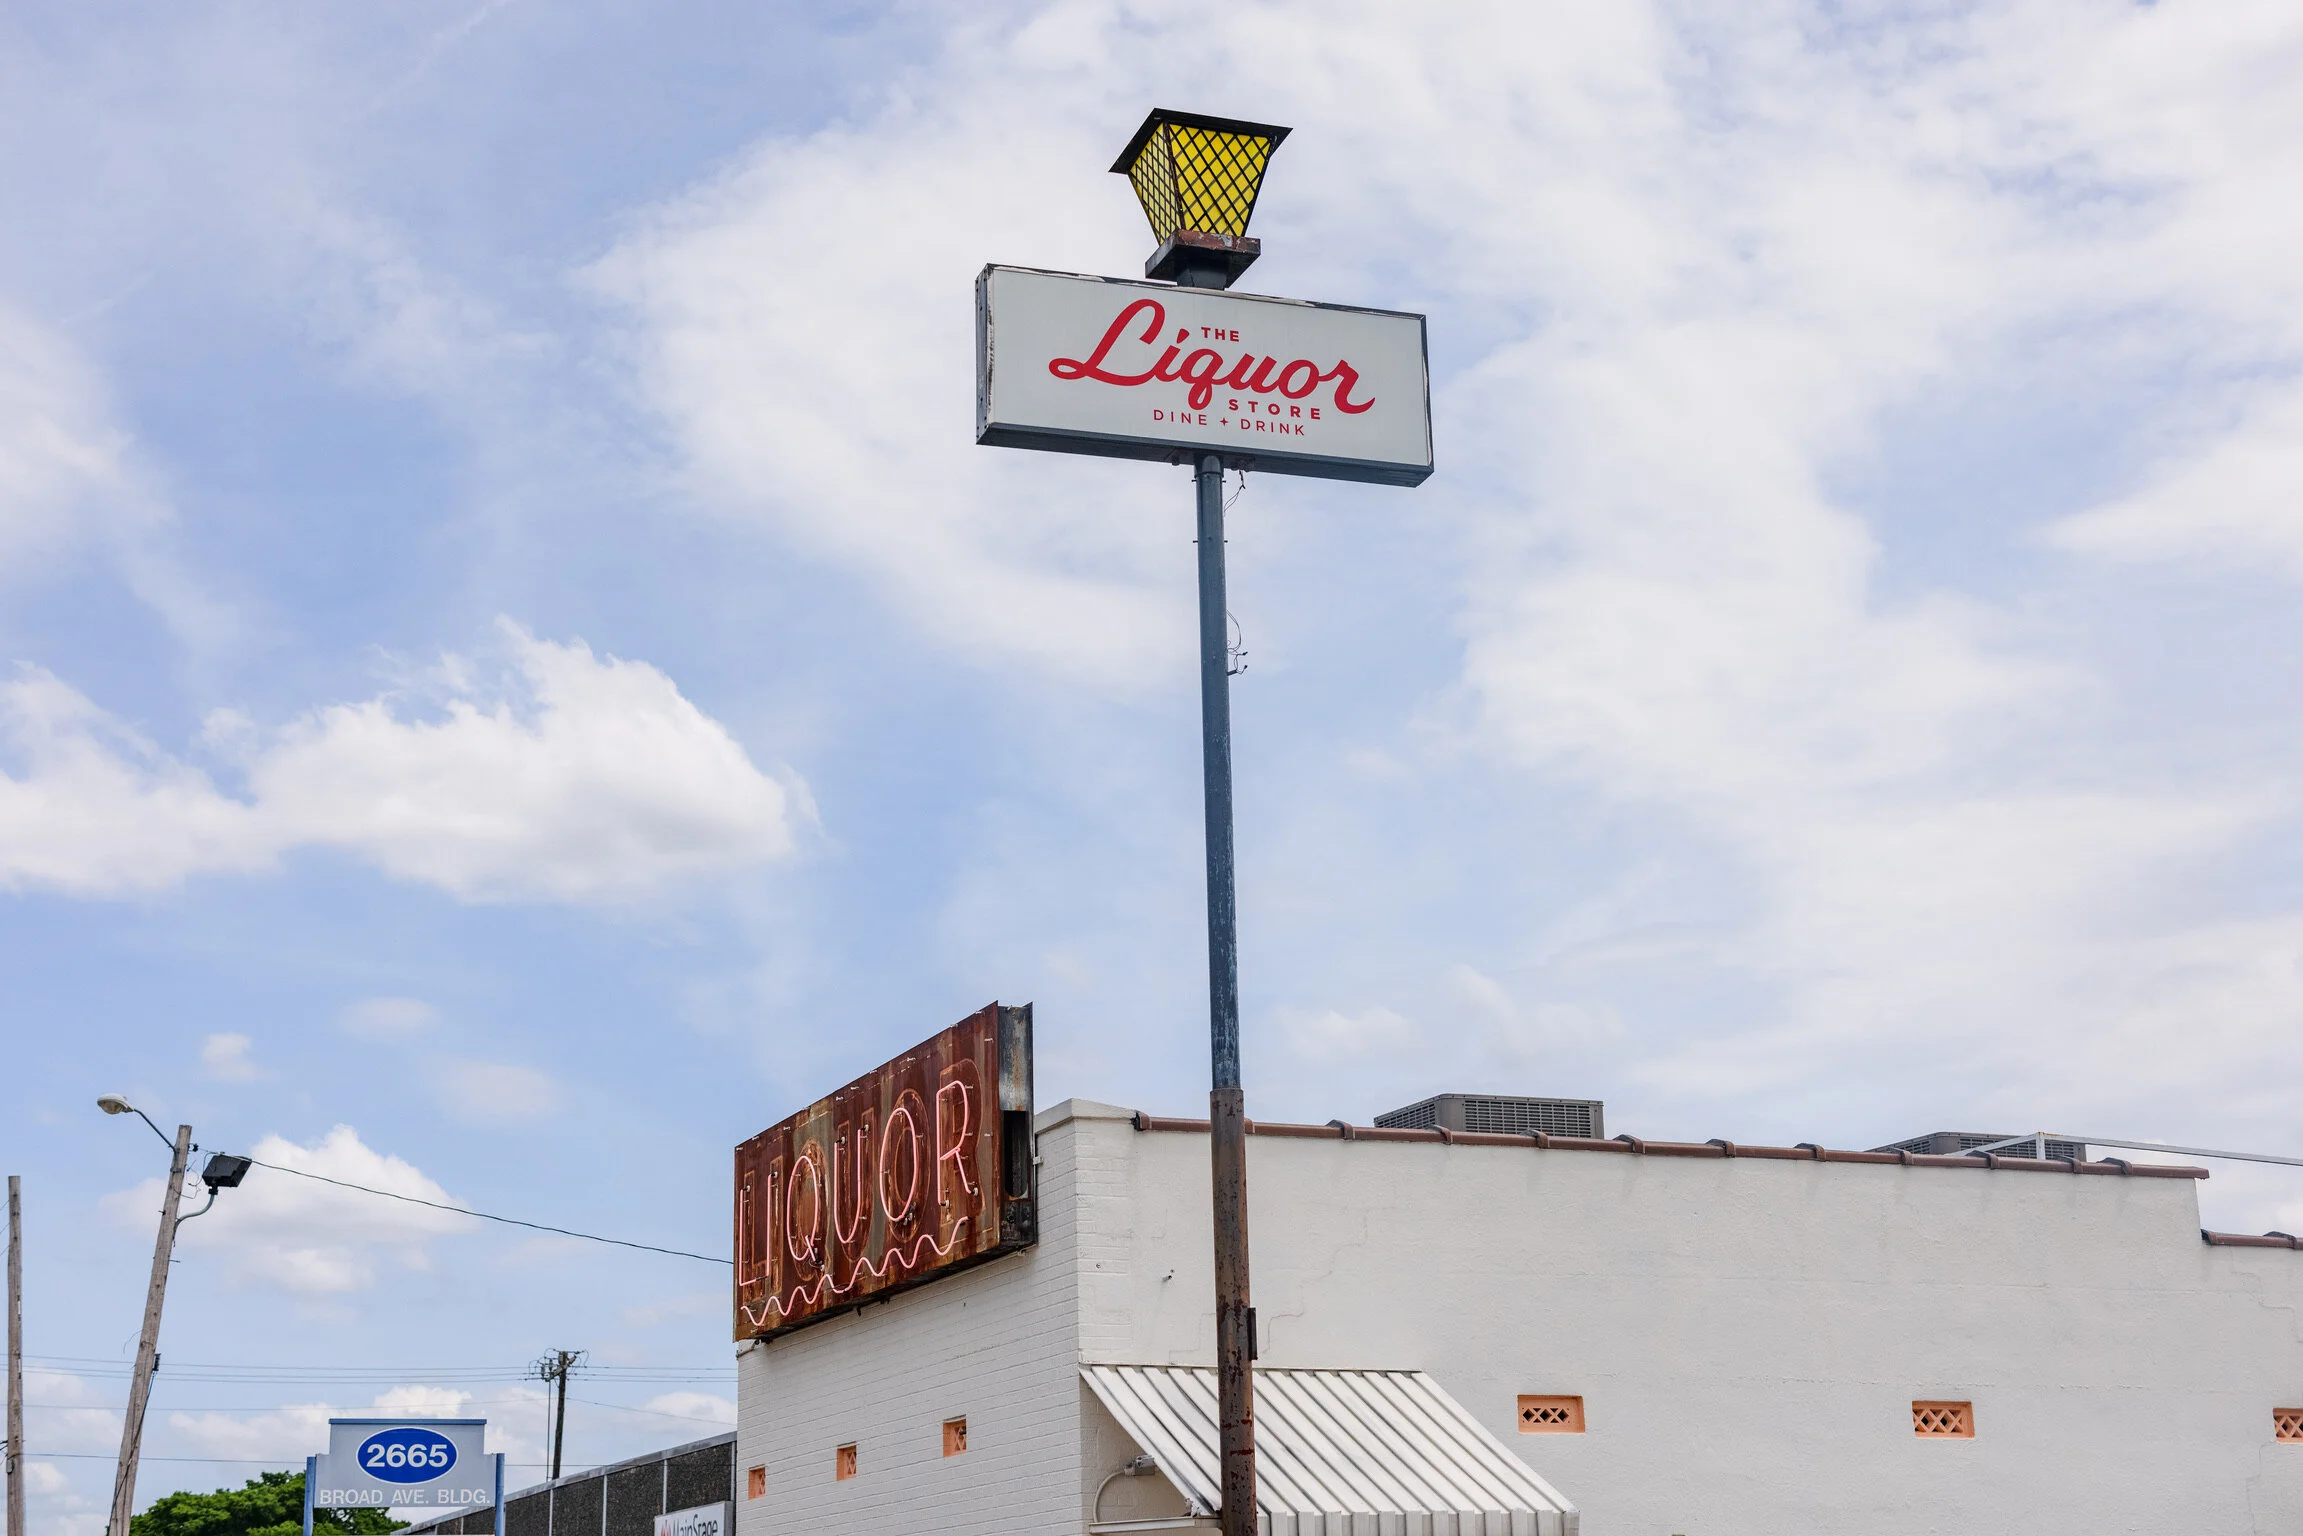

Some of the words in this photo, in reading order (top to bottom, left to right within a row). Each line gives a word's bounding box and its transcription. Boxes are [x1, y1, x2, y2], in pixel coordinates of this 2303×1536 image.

[1201, 326, 1239, 343] THE
[1048, 299, 1376, 415] Liquor
[1228, 398, 1321, 421] STORE
[1153, 408, 1208, 426] DINE
[1219, 417, 1229, 428] +
[1240, 419, 1306, 437] DRINK
[739, 1058, 986, 1300] LIQUOR
[365, 1443, 449, 1468] 2665
[319, 1489, 384, 1505] BROAD
[391, 1489, 429, 1505] AVE.
[437, 1488, 491, 1505] BLDG.
